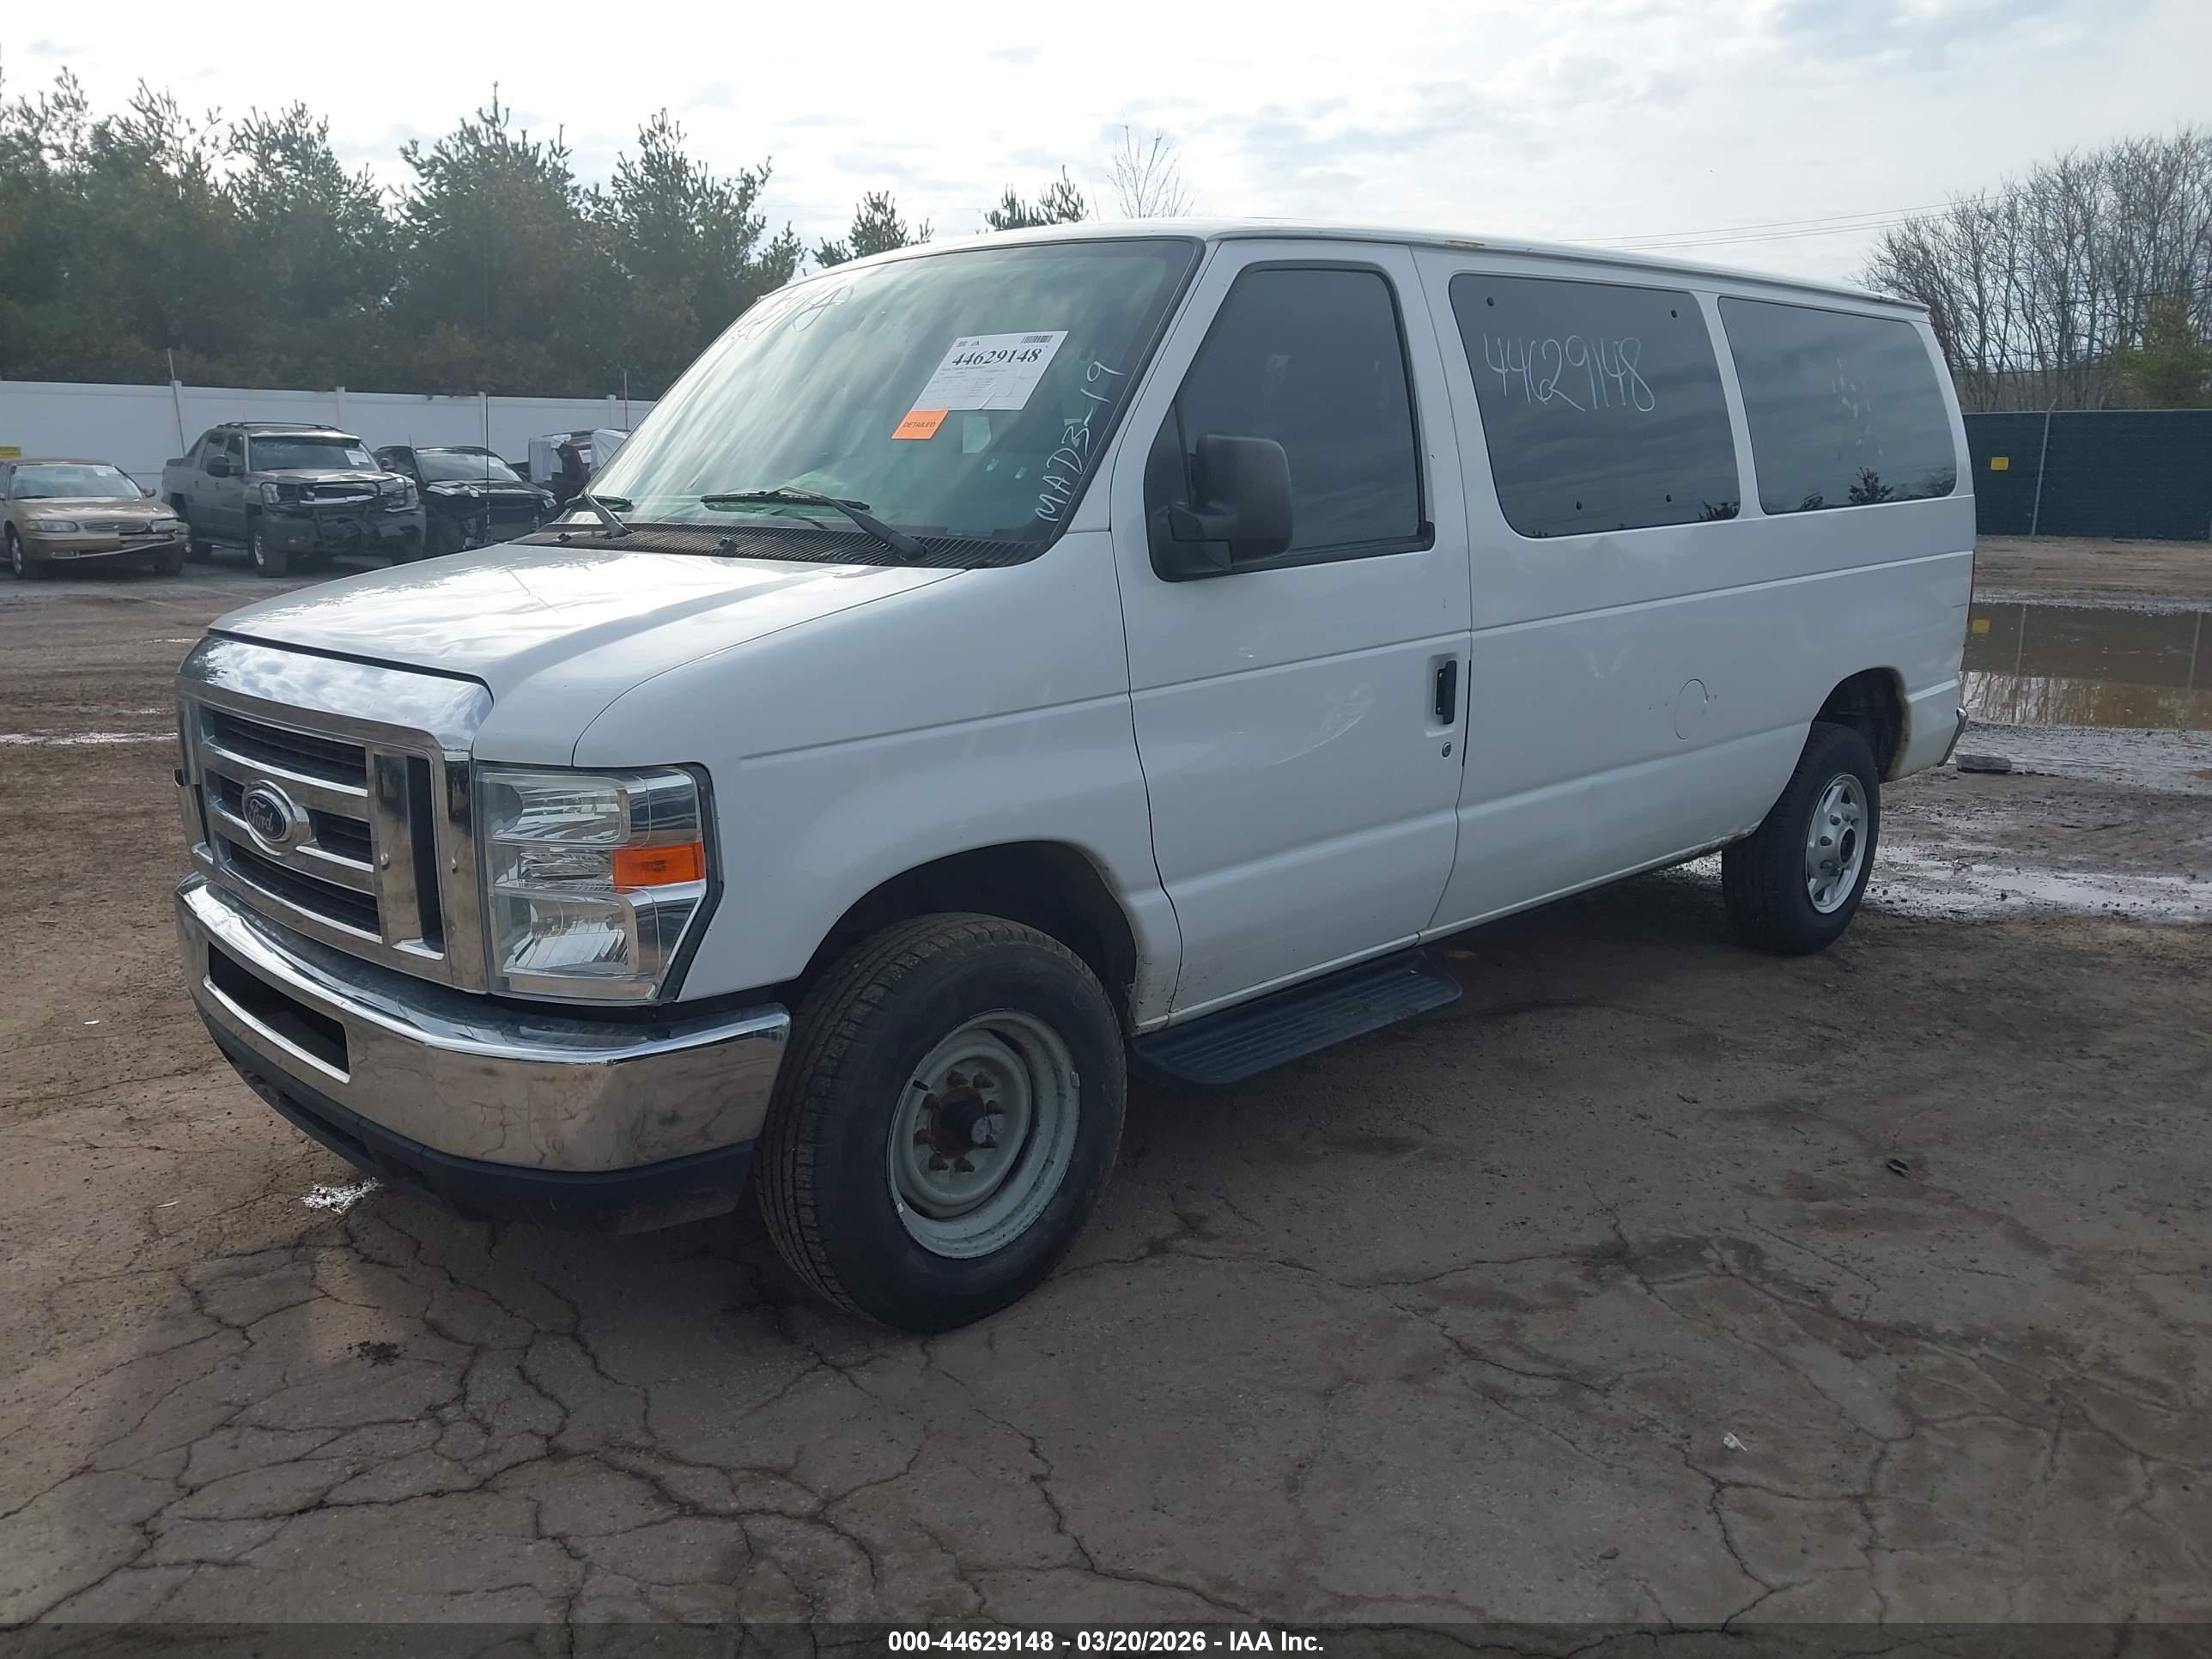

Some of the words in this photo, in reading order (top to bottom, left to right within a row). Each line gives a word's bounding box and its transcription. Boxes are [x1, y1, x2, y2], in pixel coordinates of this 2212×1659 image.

[951, 348, 1042, 367] 44629148
[1483, 333, 1656, 412] 44629148
[248, 798, 275, 832] Ford
